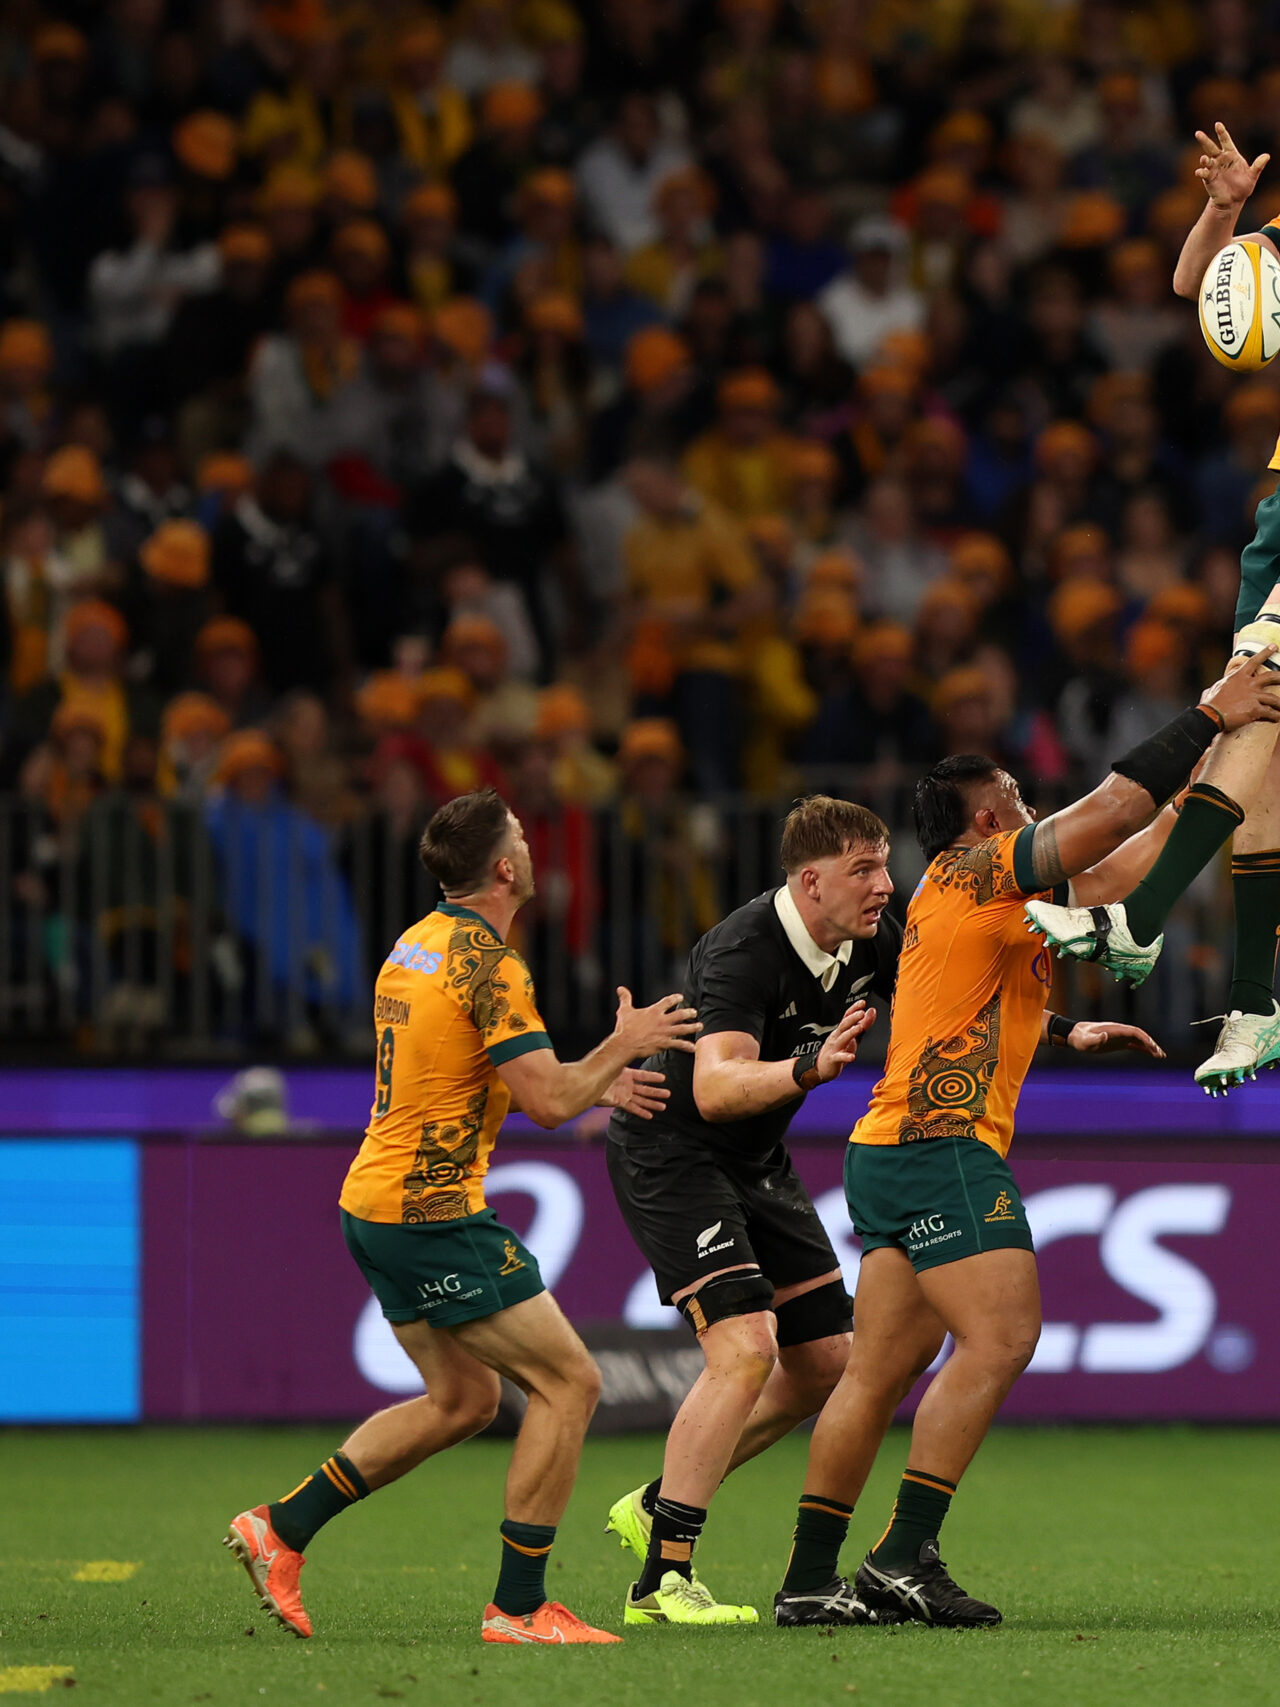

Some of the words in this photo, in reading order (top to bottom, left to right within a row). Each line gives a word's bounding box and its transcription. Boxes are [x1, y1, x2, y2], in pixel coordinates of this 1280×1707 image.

[1216, 251, 1236, 345] GILBERT
[376, 994, 411, 1026] GORDON
[790, 1040, 822, 1058] ALTR
[377, 1026, 395, 1118] 9
[930, 1229, 962, 1245] RESORTS
